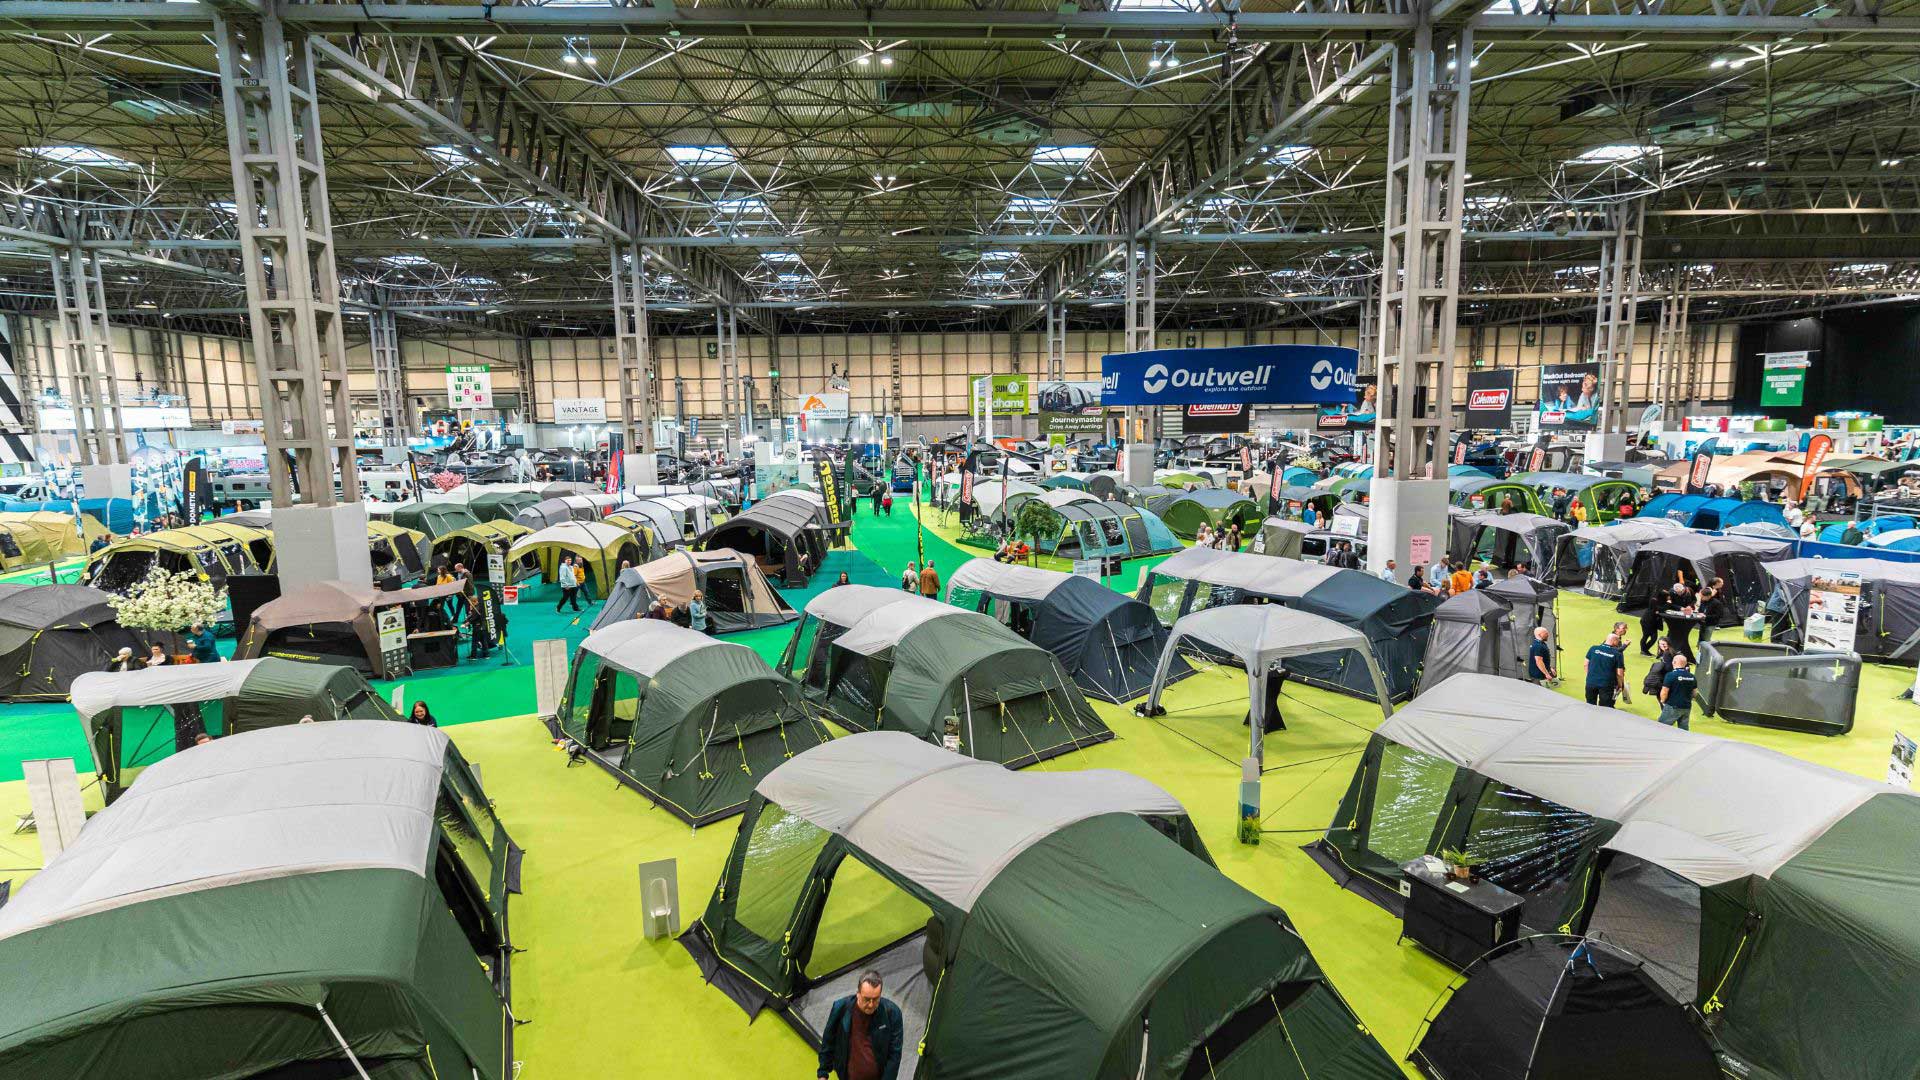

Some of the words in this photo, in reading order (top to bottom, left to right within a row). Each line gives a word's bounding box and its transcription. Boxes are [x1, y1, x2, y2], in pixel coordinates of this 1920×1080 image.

[1171, 366, 1273, 387] Outwell
[1472, 392, 1500, 405] Coleman
[1050, 416, 1103, 424] Journeymaster
[1806, 441, 1828, 474] TRIGANO
